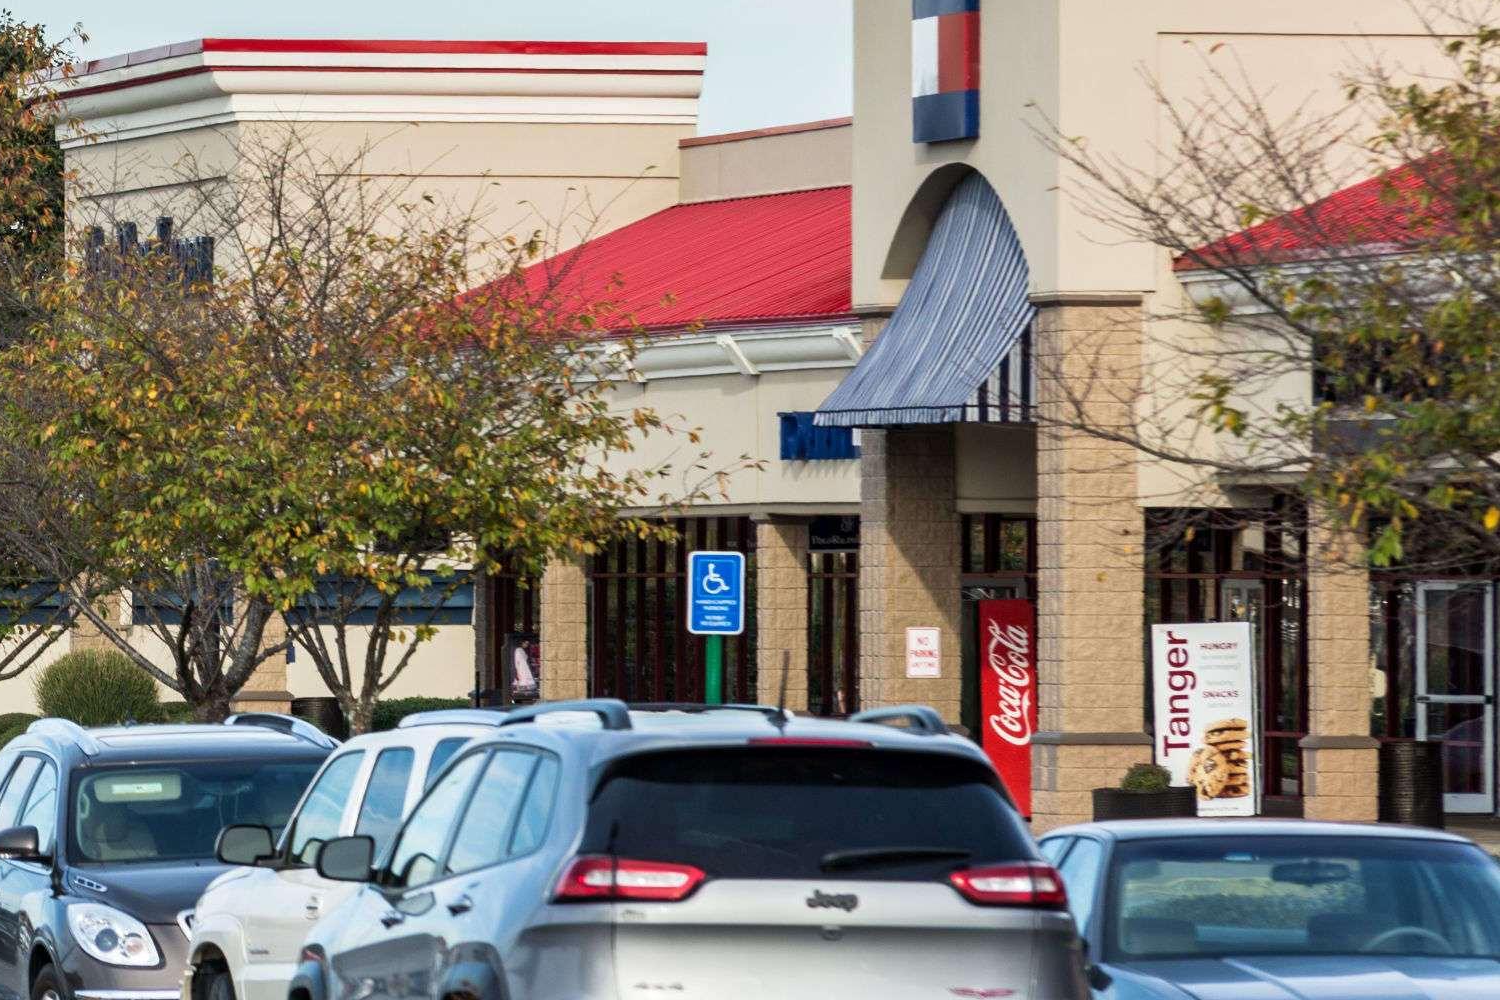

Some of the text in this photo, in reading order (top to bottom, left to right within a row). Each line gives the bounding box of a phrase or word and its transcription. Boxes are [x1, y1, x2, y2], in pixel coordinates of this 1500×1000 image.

[1200, 642, 1238, 650] HUNGRY
[988, 617, 1031, 746] Coca-Cola
[1163, 630, 1197, 758] Tanger
[1203, 690, 1239, 698] SNACKS
[806, 889, 858, 912] Jeep
